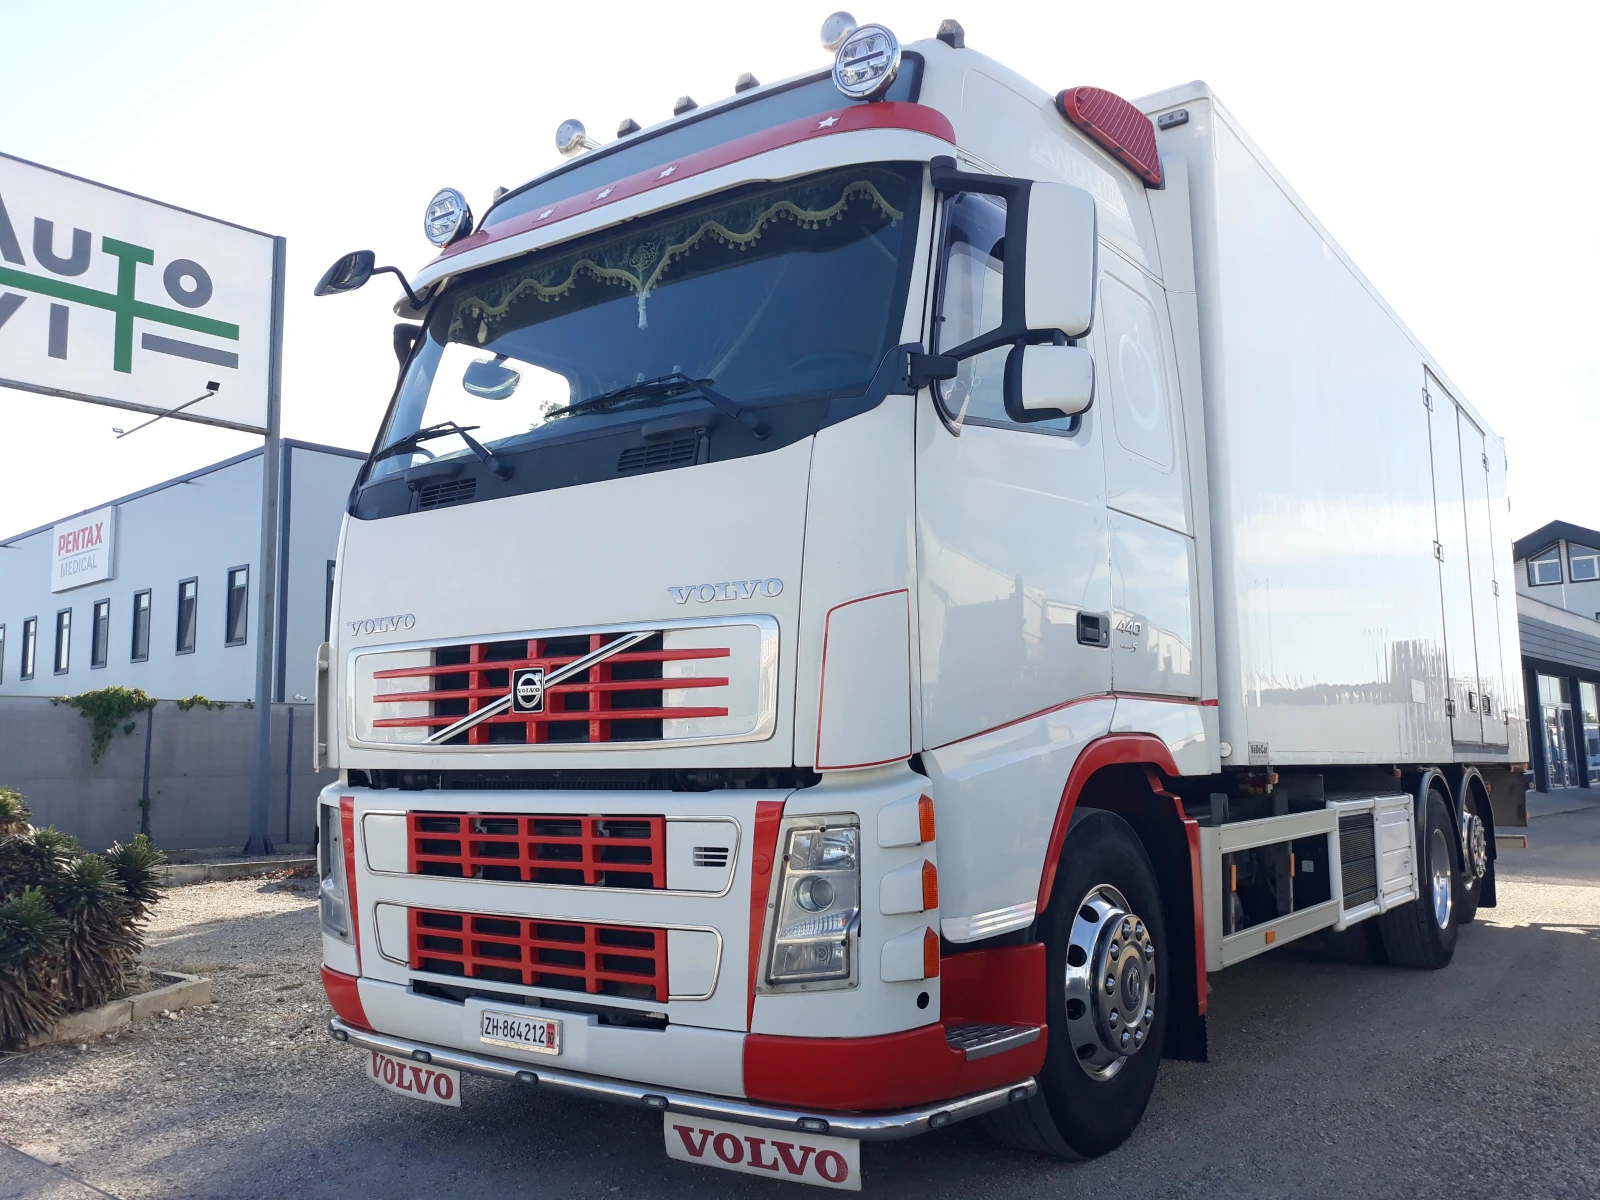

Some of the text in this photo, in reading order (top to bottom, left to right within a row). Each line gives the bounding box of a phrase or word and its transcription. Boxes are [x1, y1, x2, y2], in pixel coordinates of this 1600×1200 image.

[58, 522, 103, 556] PENTAX
[60, 554, 97, 577] MEDICAL
[667, 577, 784, 604] VOLVO
[346, 613, 416, 636] VOLVO
[1116, 619, 1142, 636] 440
[371, 1051, 454, 1100] VOLVO
[673, 1125, 849, 1183] VOLVO
